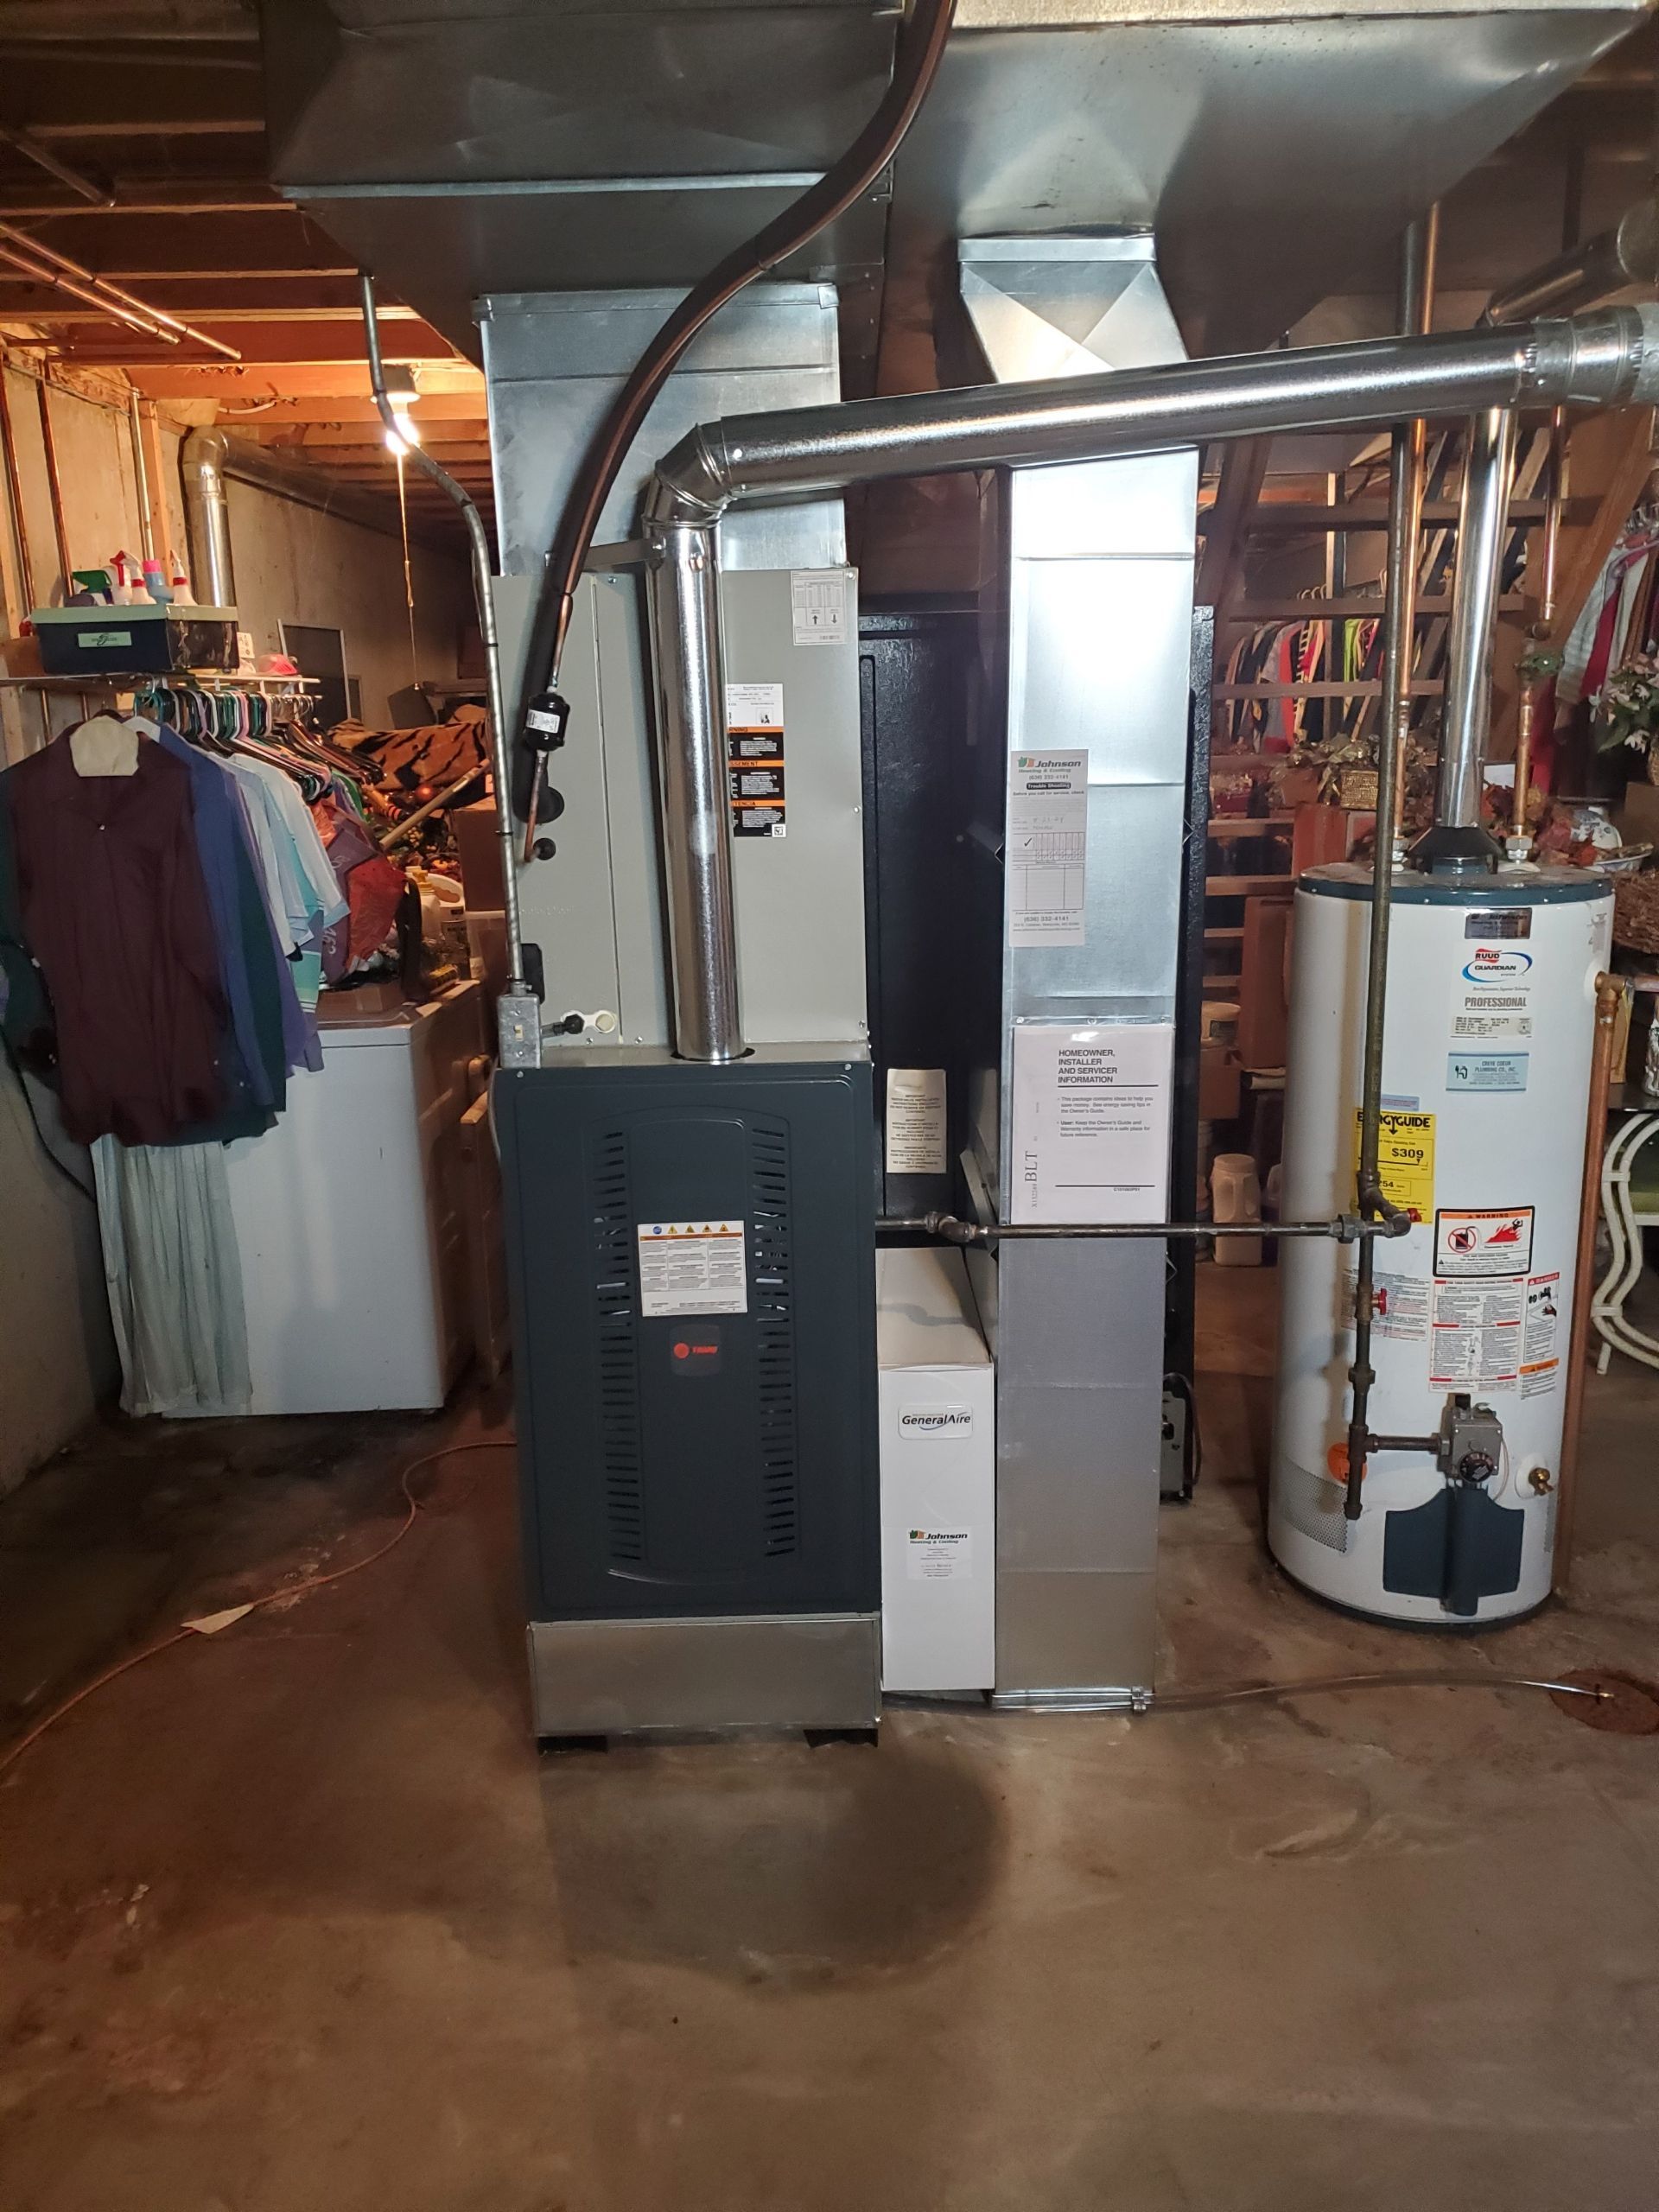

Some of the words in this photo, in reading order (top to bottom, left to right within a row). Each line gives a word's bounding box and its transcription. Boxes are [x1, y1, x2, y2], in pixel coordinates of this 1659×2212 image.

[1465, 997, 1527, 1007] PROFESSIONAL
[1058, 1049, 1116, 1058] HOMEOWNER,
[1391, 1147, 1424, 1159] $309
[1025, 1150, 1038, 1182] BLT
[902, 1414, 971, 1425] GeneralAire
